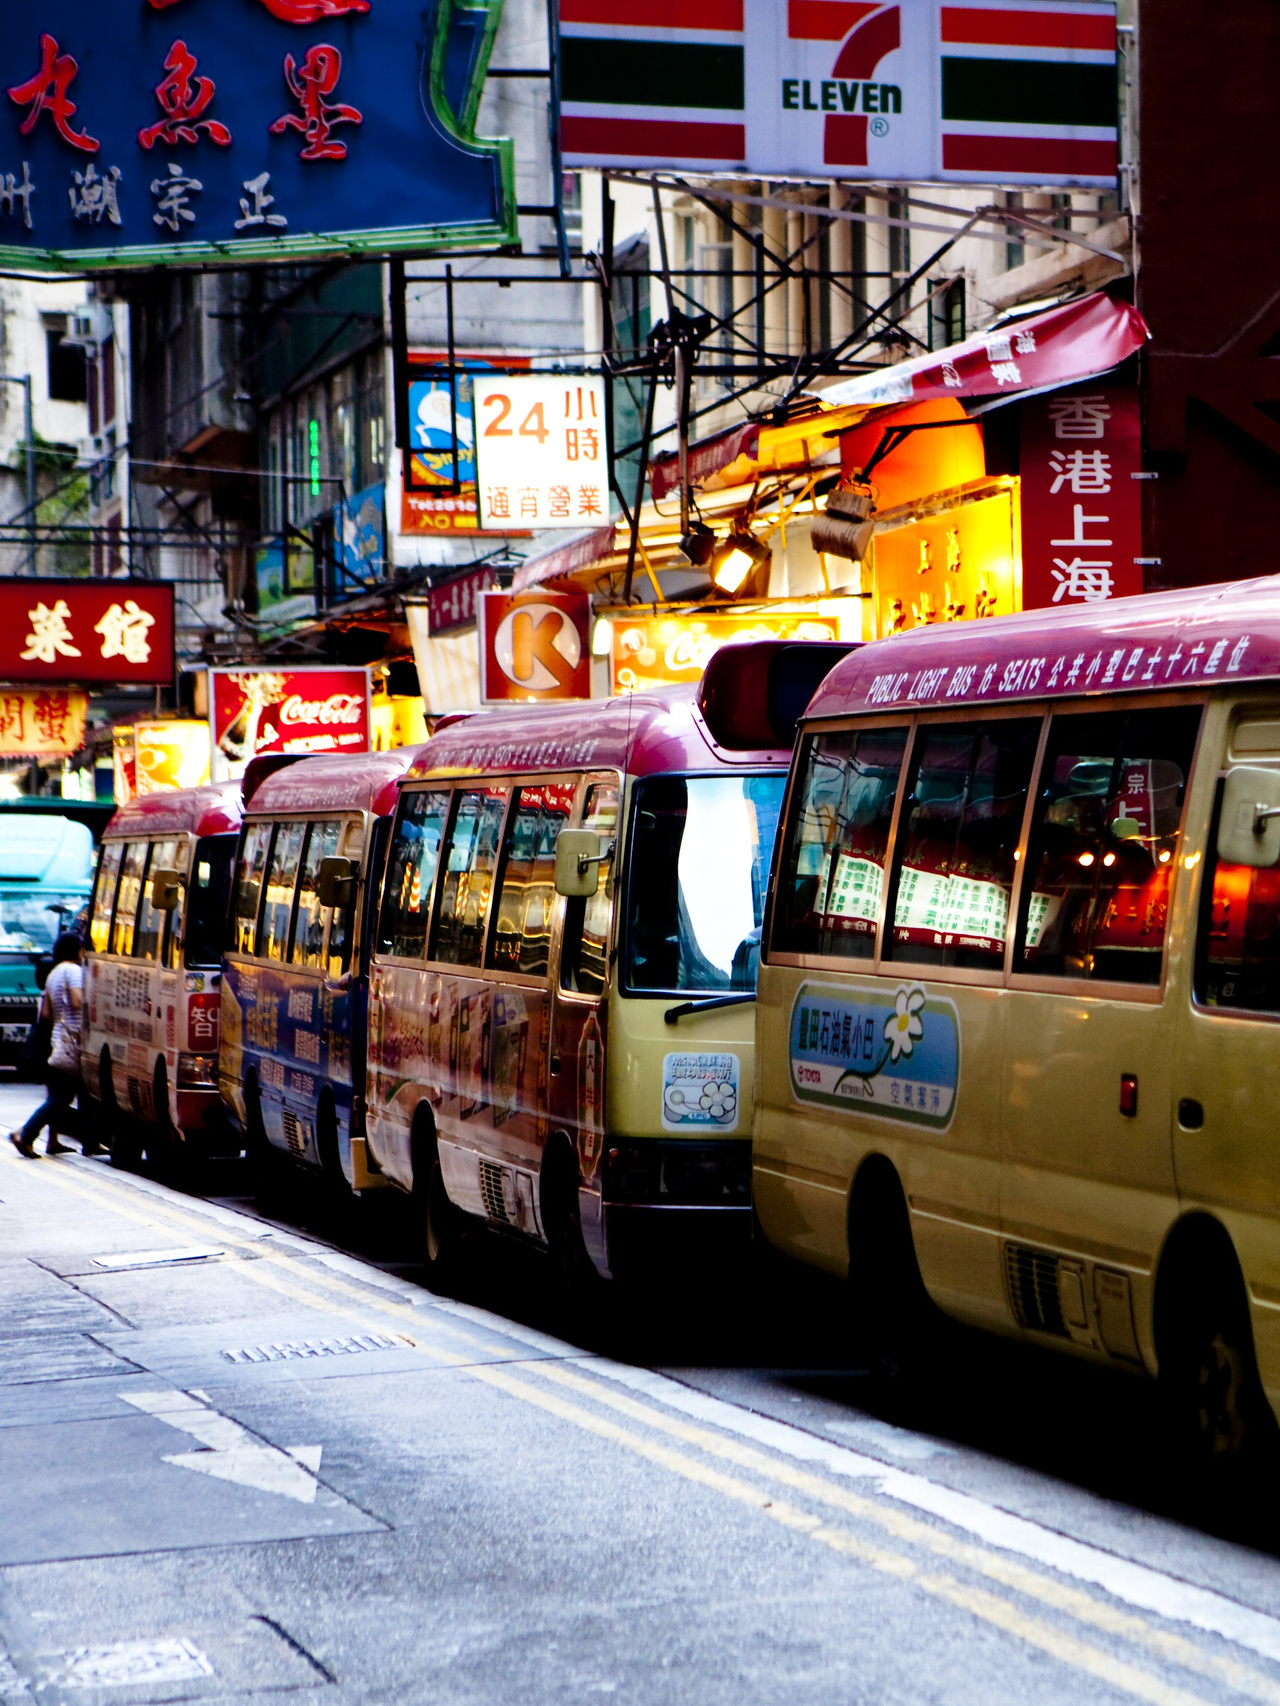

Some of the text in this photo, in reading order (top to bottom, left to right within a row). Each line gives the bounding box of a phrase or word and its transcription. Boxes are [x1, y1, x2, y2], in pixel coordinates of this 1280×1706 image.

[482, 393, 550, 445] 24
[564, 386, 599, 462] 小時
[486, 483, 603, 519] 通宵營業
[1048, 395, 1115, 603] 香港上海
[19, 599, 156, 663] 菜館
[867, 672, 909, 704] PUBLIC
[906, 667, 950, 700] LIGHT
[945, 665, 978, 698] BUS
[976, 663, 998, 695] 16
[997, 657, 1047, 693] SEATS
